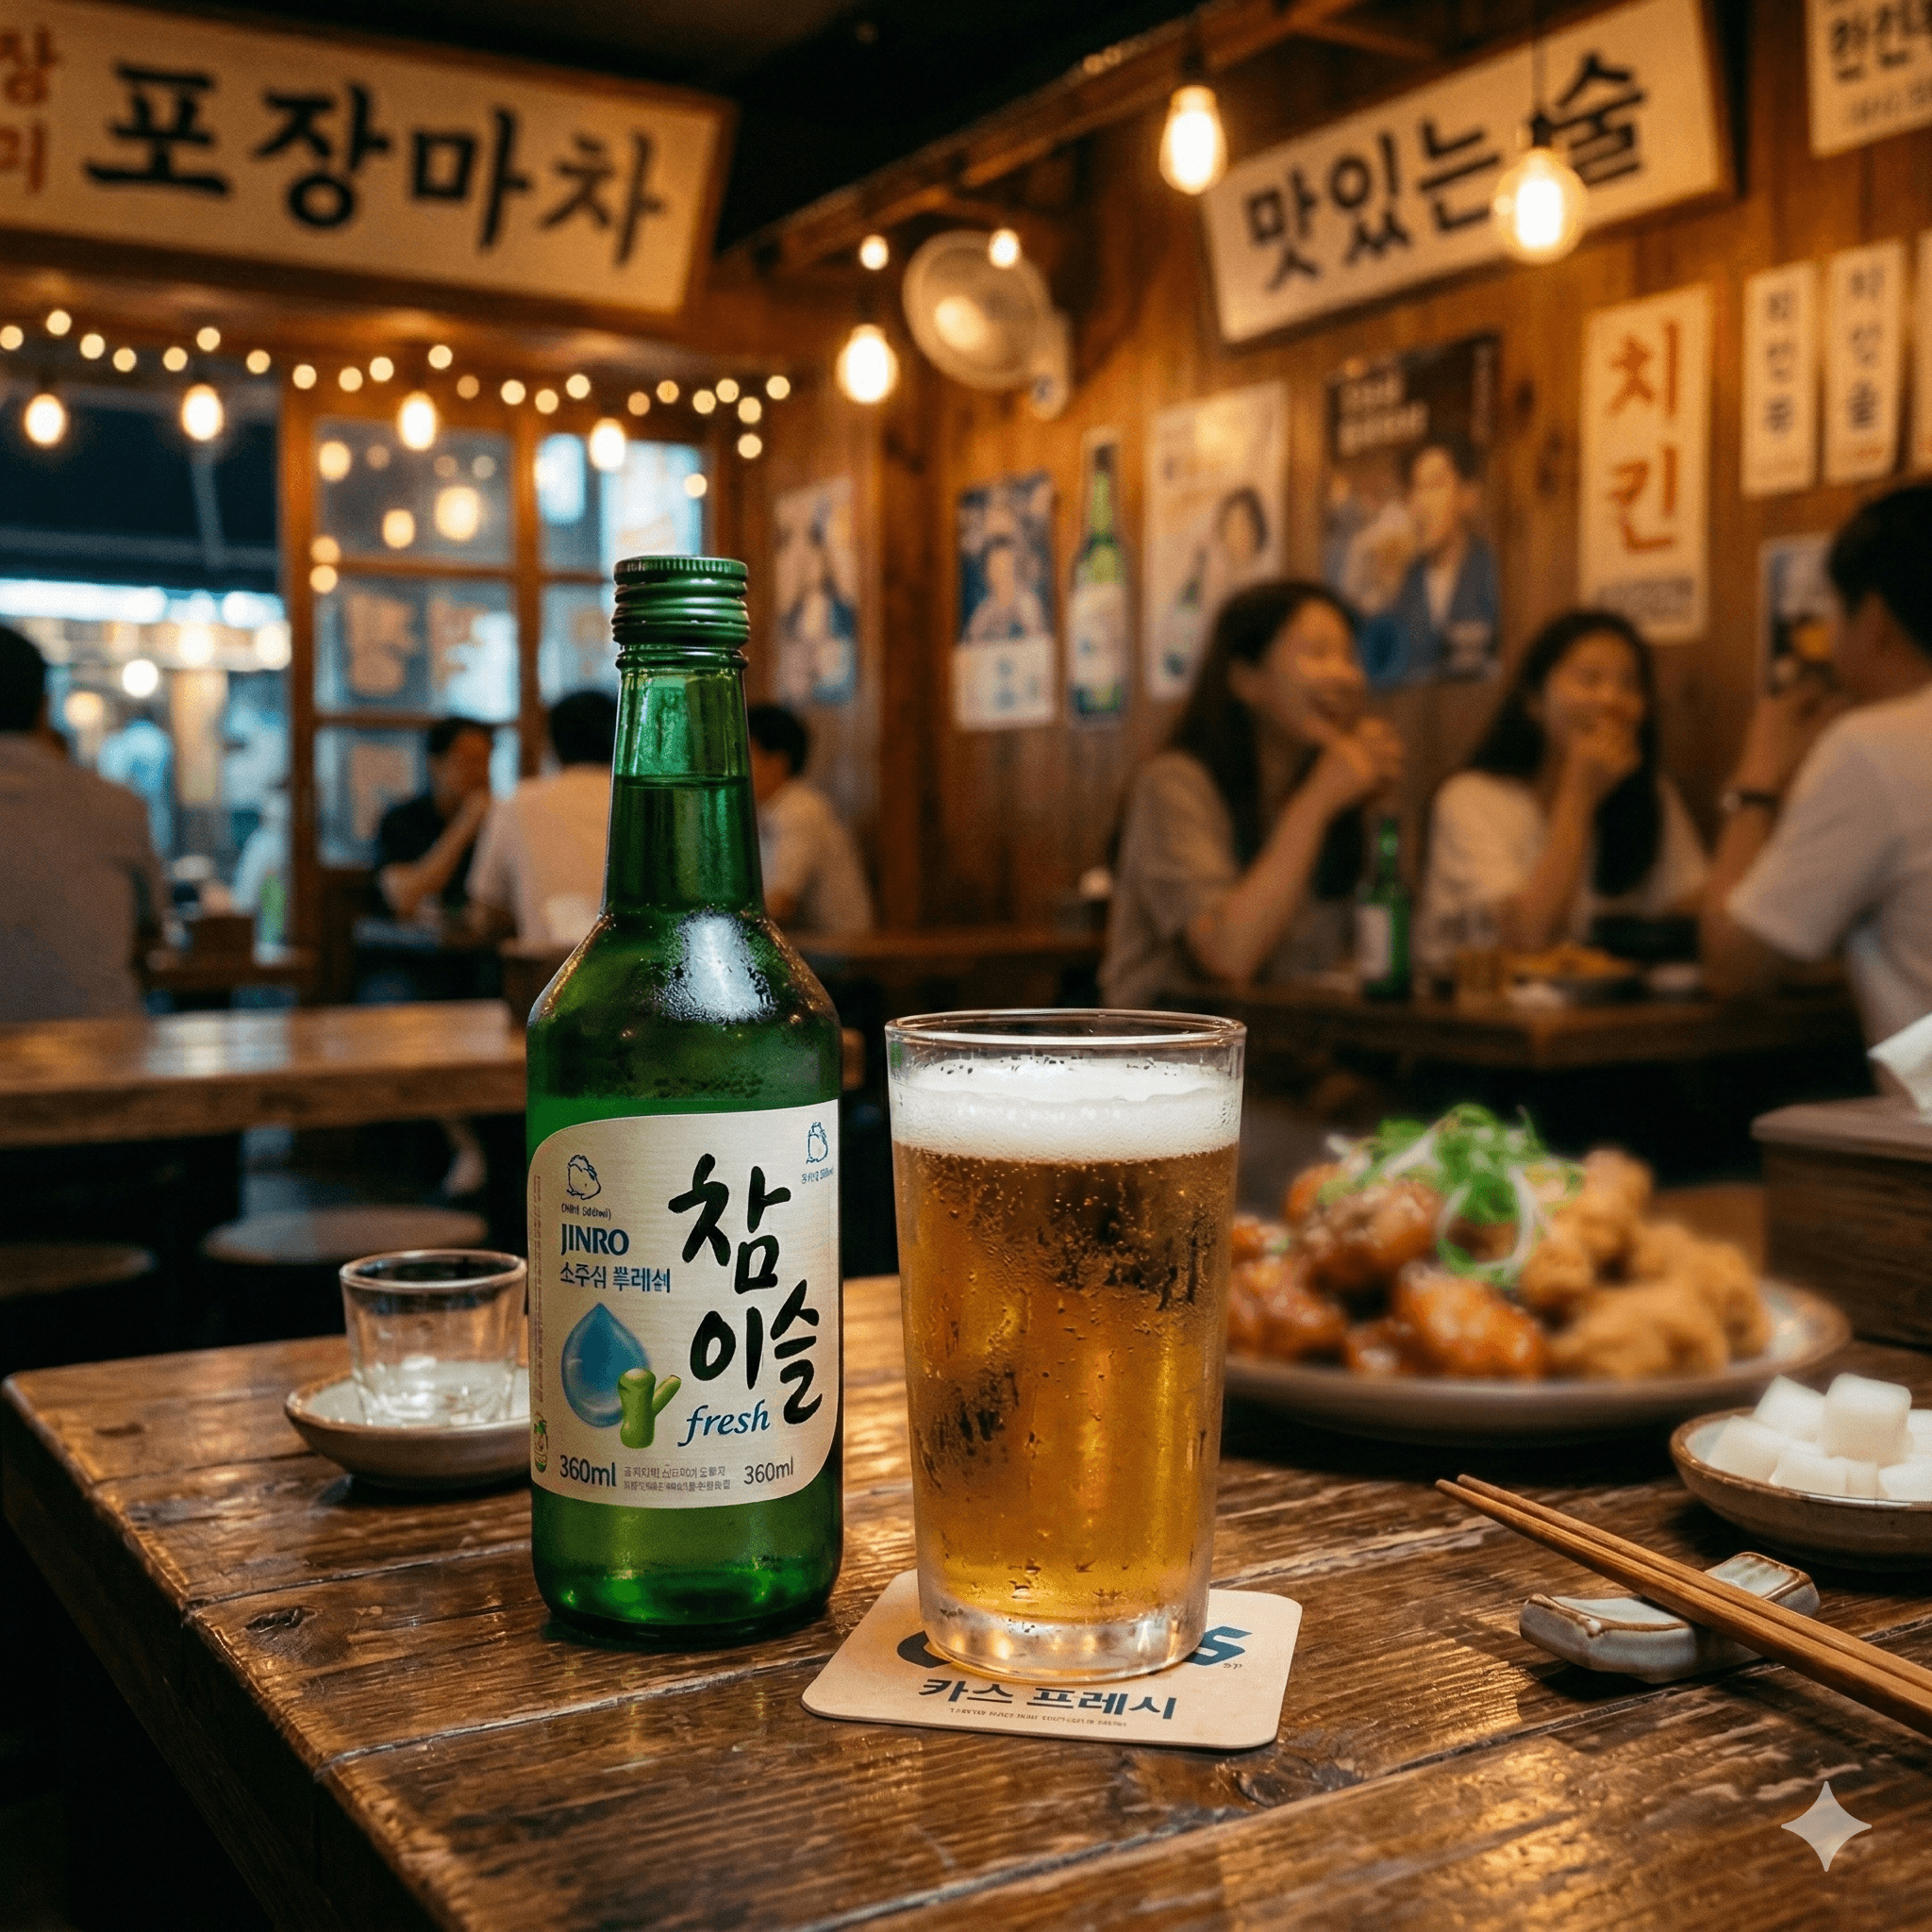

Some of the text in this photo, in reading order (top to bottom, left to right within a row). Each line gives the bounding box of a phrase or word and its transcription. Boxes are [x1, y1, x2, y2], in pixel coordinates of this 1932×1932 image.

[83, 58, 668, 268] 포장마차
[1243, 113, 1502, 294] 맛있는
[1607, 318, 1679, 556] 치킨
[560, 1223, 629, 1256] JINRO
[668, 1153, 791, 1294] 참
[690, 1278, 823, 1425] 이슬
[677, 1398, 771, 1447] fresh
[743, 1455, 793, 1485] 360ml
[559, 1454, 616, 1487] 360ml
[918, 1678, 1013, 1705] 카스
[1025, 1687, 1177, 1720] 프레시
